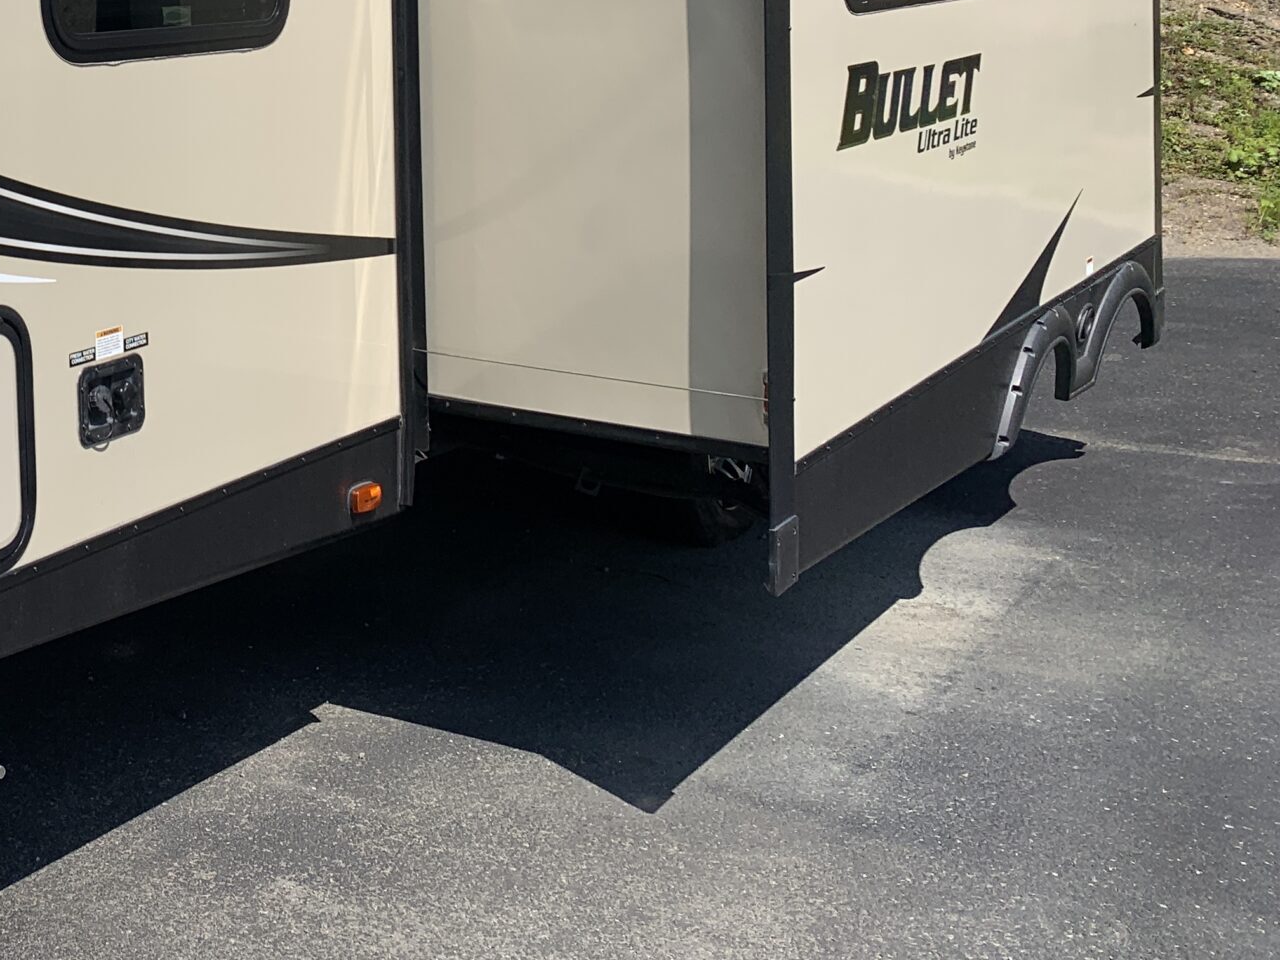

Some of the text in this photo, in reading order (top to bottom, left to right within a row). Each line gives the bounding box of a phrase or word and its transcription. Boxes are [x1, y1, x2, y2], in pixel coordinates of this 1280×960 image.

[836, 53, 982, 152] BULLET
[917, 117, 978, 154] Ultra Lite
[949, 148, 955, 160] by
